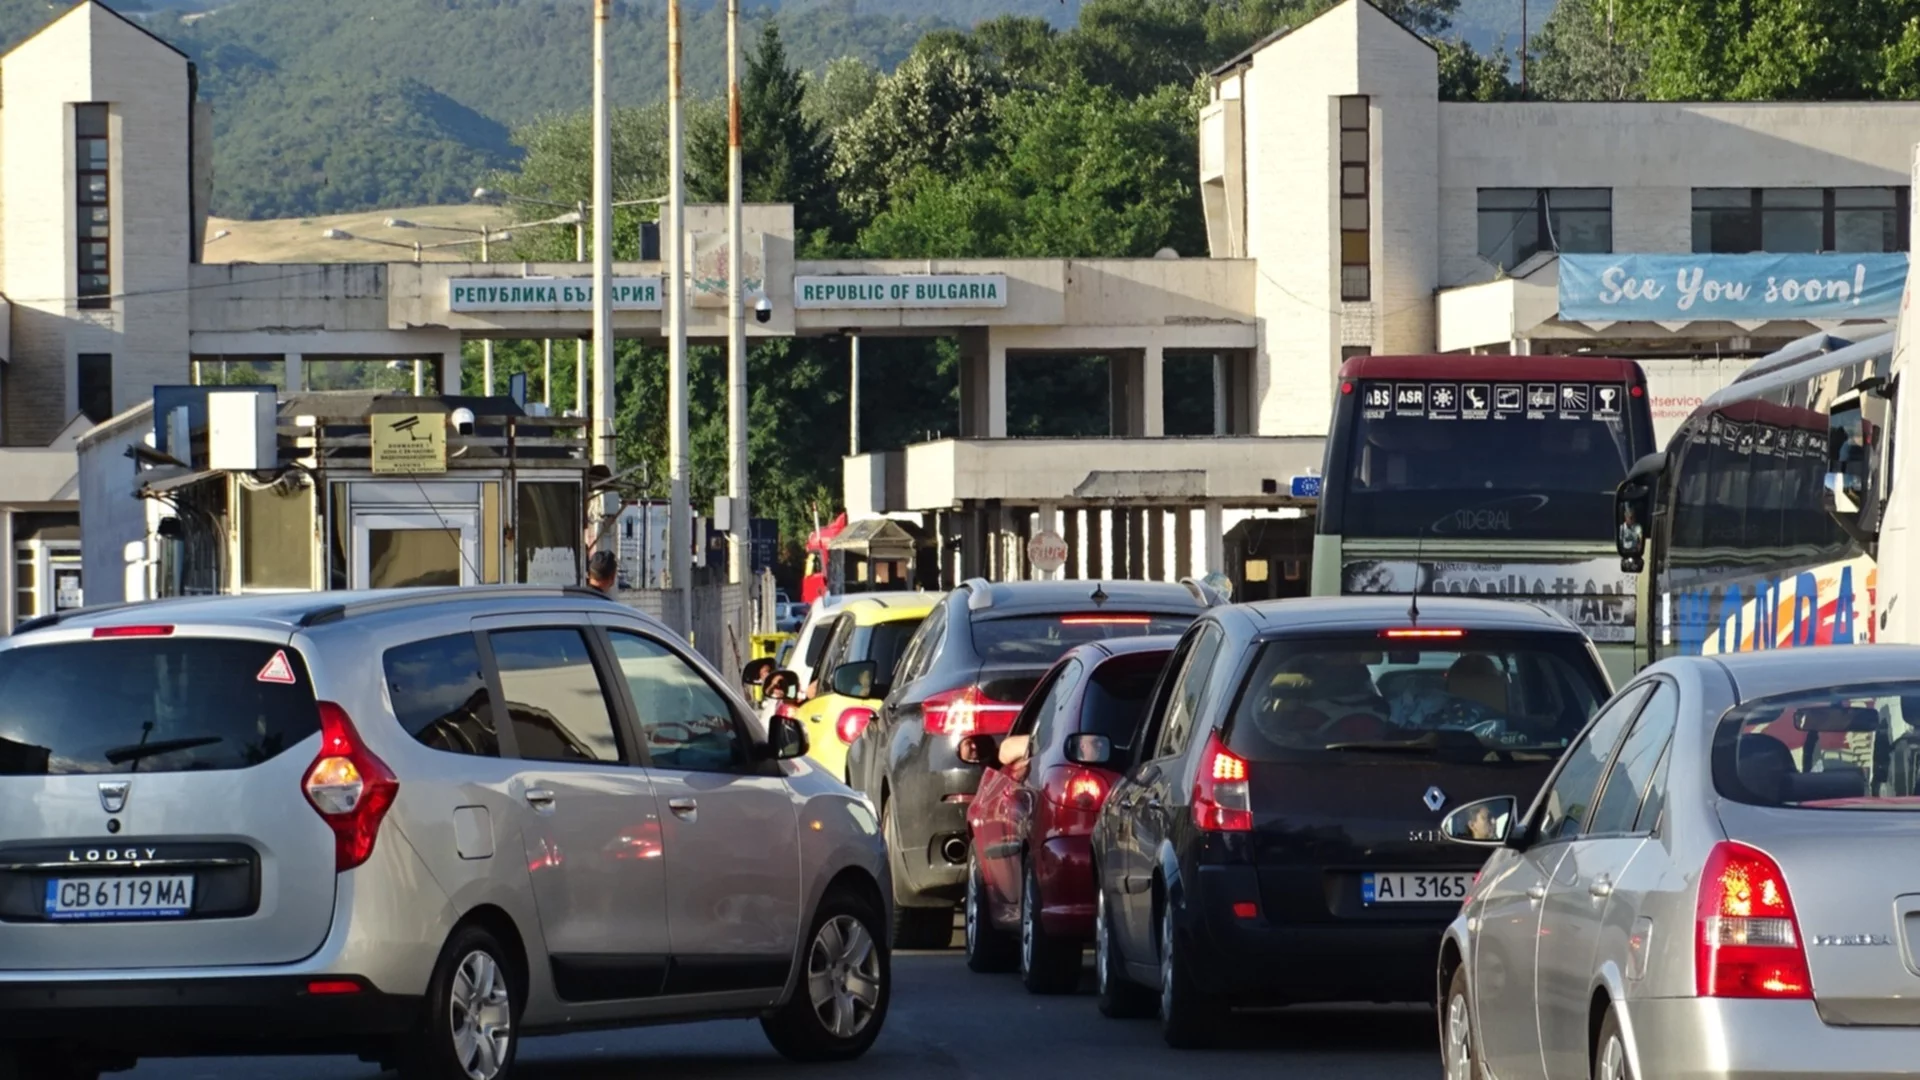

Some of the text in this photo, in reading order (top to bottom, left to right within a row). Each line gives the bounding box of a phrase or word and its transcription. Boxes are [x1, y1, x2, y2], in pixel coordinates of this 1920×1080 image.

[454, 286, 655, 303] РЕПУБЛИКА БЪАРИЯ
[803, 283, 997, 300] REPUBLIC OF BULGARIA
[1599, 266, 1665, 304] See
[1677, 267, 1752, 310] You
[1764, 264, 1866, 305] soon!
[1365, 390, 1423, 406] ABS ASR
[1455, 509, 1512, 530] SIDERAL
[69, 848, 156, 862] LODGY
